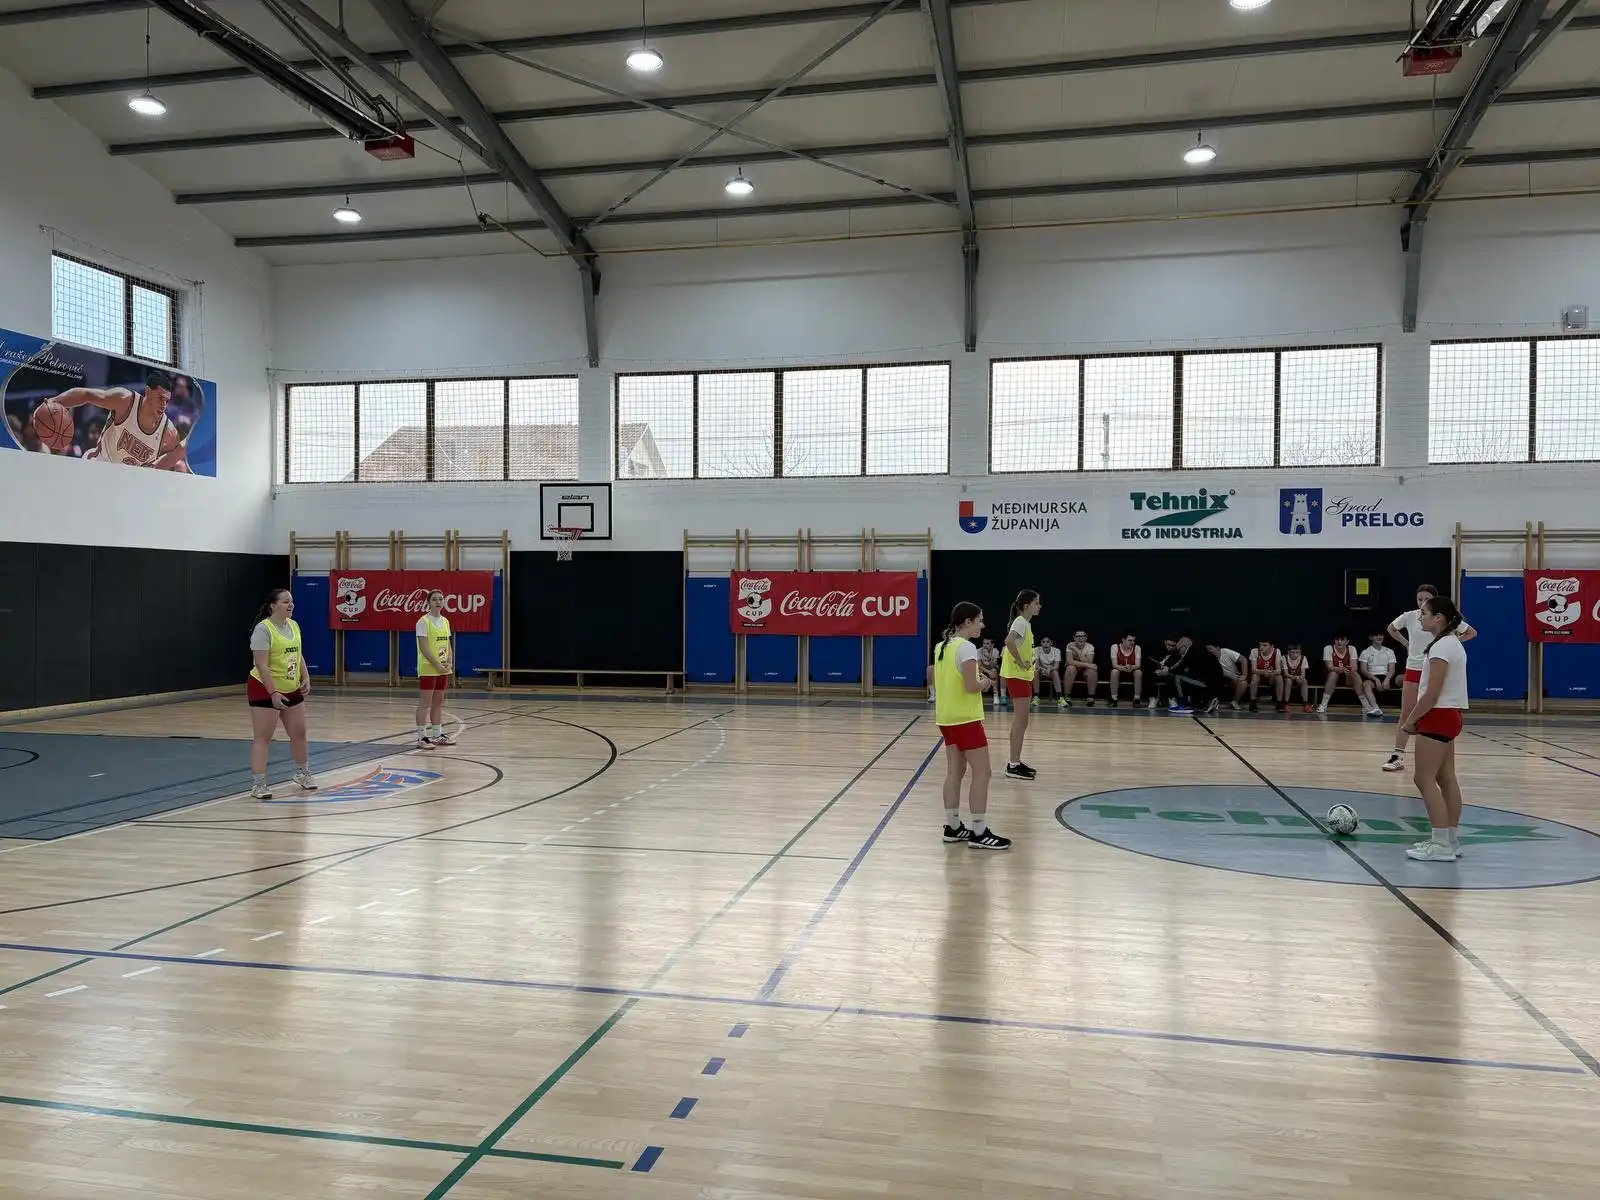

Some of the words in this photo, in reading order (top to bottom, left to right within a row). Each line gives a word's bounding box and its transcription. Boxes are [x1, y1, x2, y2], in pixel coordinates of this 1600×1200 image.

[39, 352, 83, 373] Petrović
[992, 502, 1088, 514] MEĐIMURSKA
[1325, 496, 1383, 515] Grad
[992, 516, 1060, 532] ŽUPANIJA
[1342, 512, 1424, 527] PRELOG
[1121, 528, 1151, 539] EKO
[1155, 527, 1243, 539] INDUSTRIJA
[443, 594, 486, 613] CUP
[780, 590, 858, 616] Coca-Cola
[861, 596, 910, 616] CUP
